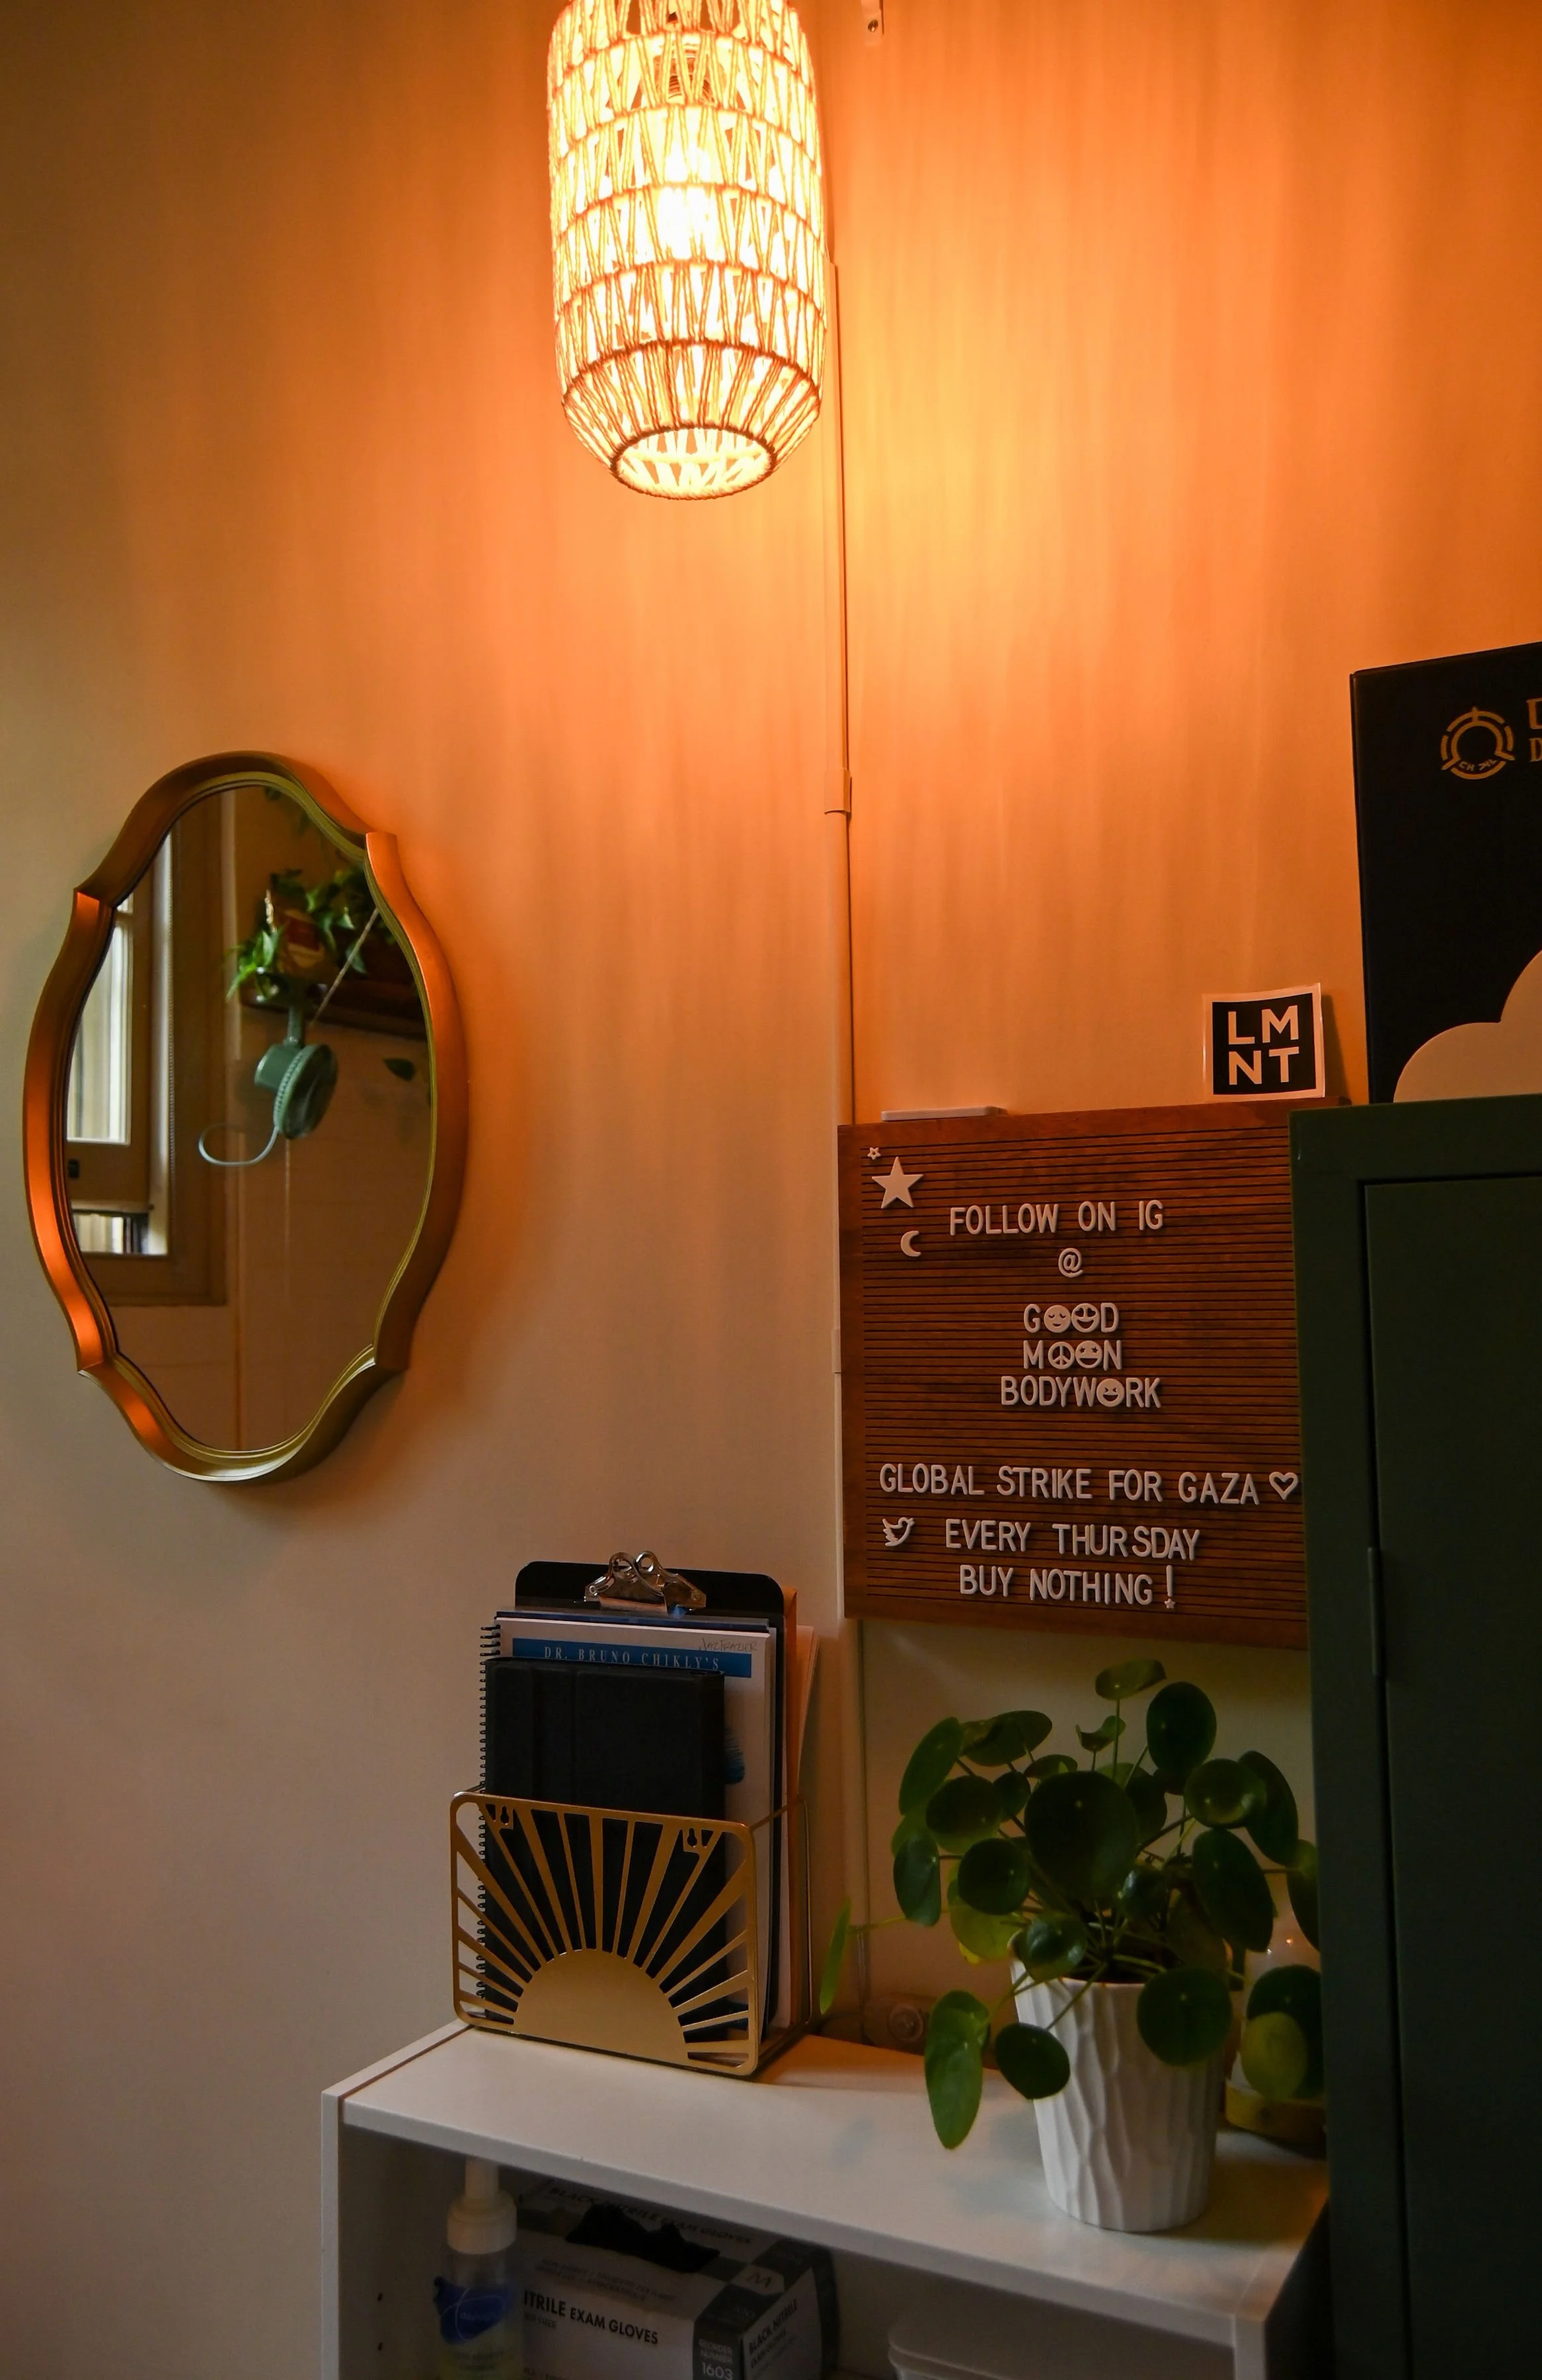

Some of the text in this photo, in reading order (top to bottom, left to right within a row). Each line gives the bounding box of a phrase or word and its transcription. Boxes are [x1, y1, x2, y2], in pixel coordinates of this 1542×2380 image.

[949, 1199, 1165, 1236] FOLLOW ON IG
[879, 1462, 1260, 1507] GLOBAL STRIKE FOR GAZA
[944, 1518, 1201, 1562] EVERY THURSDAY
[959, 1564, 1015, 1598] BUY
[544, 1646, 720, 1671] DR. BRUNO CHIKLY'S
[523, 2290, 566, 2317] ITRILE
[570, 2307, 605, 2330] EXAM
[609, 2319, 658, 2345] GLOVES
[701, 2361, 734, 2380] 1603
